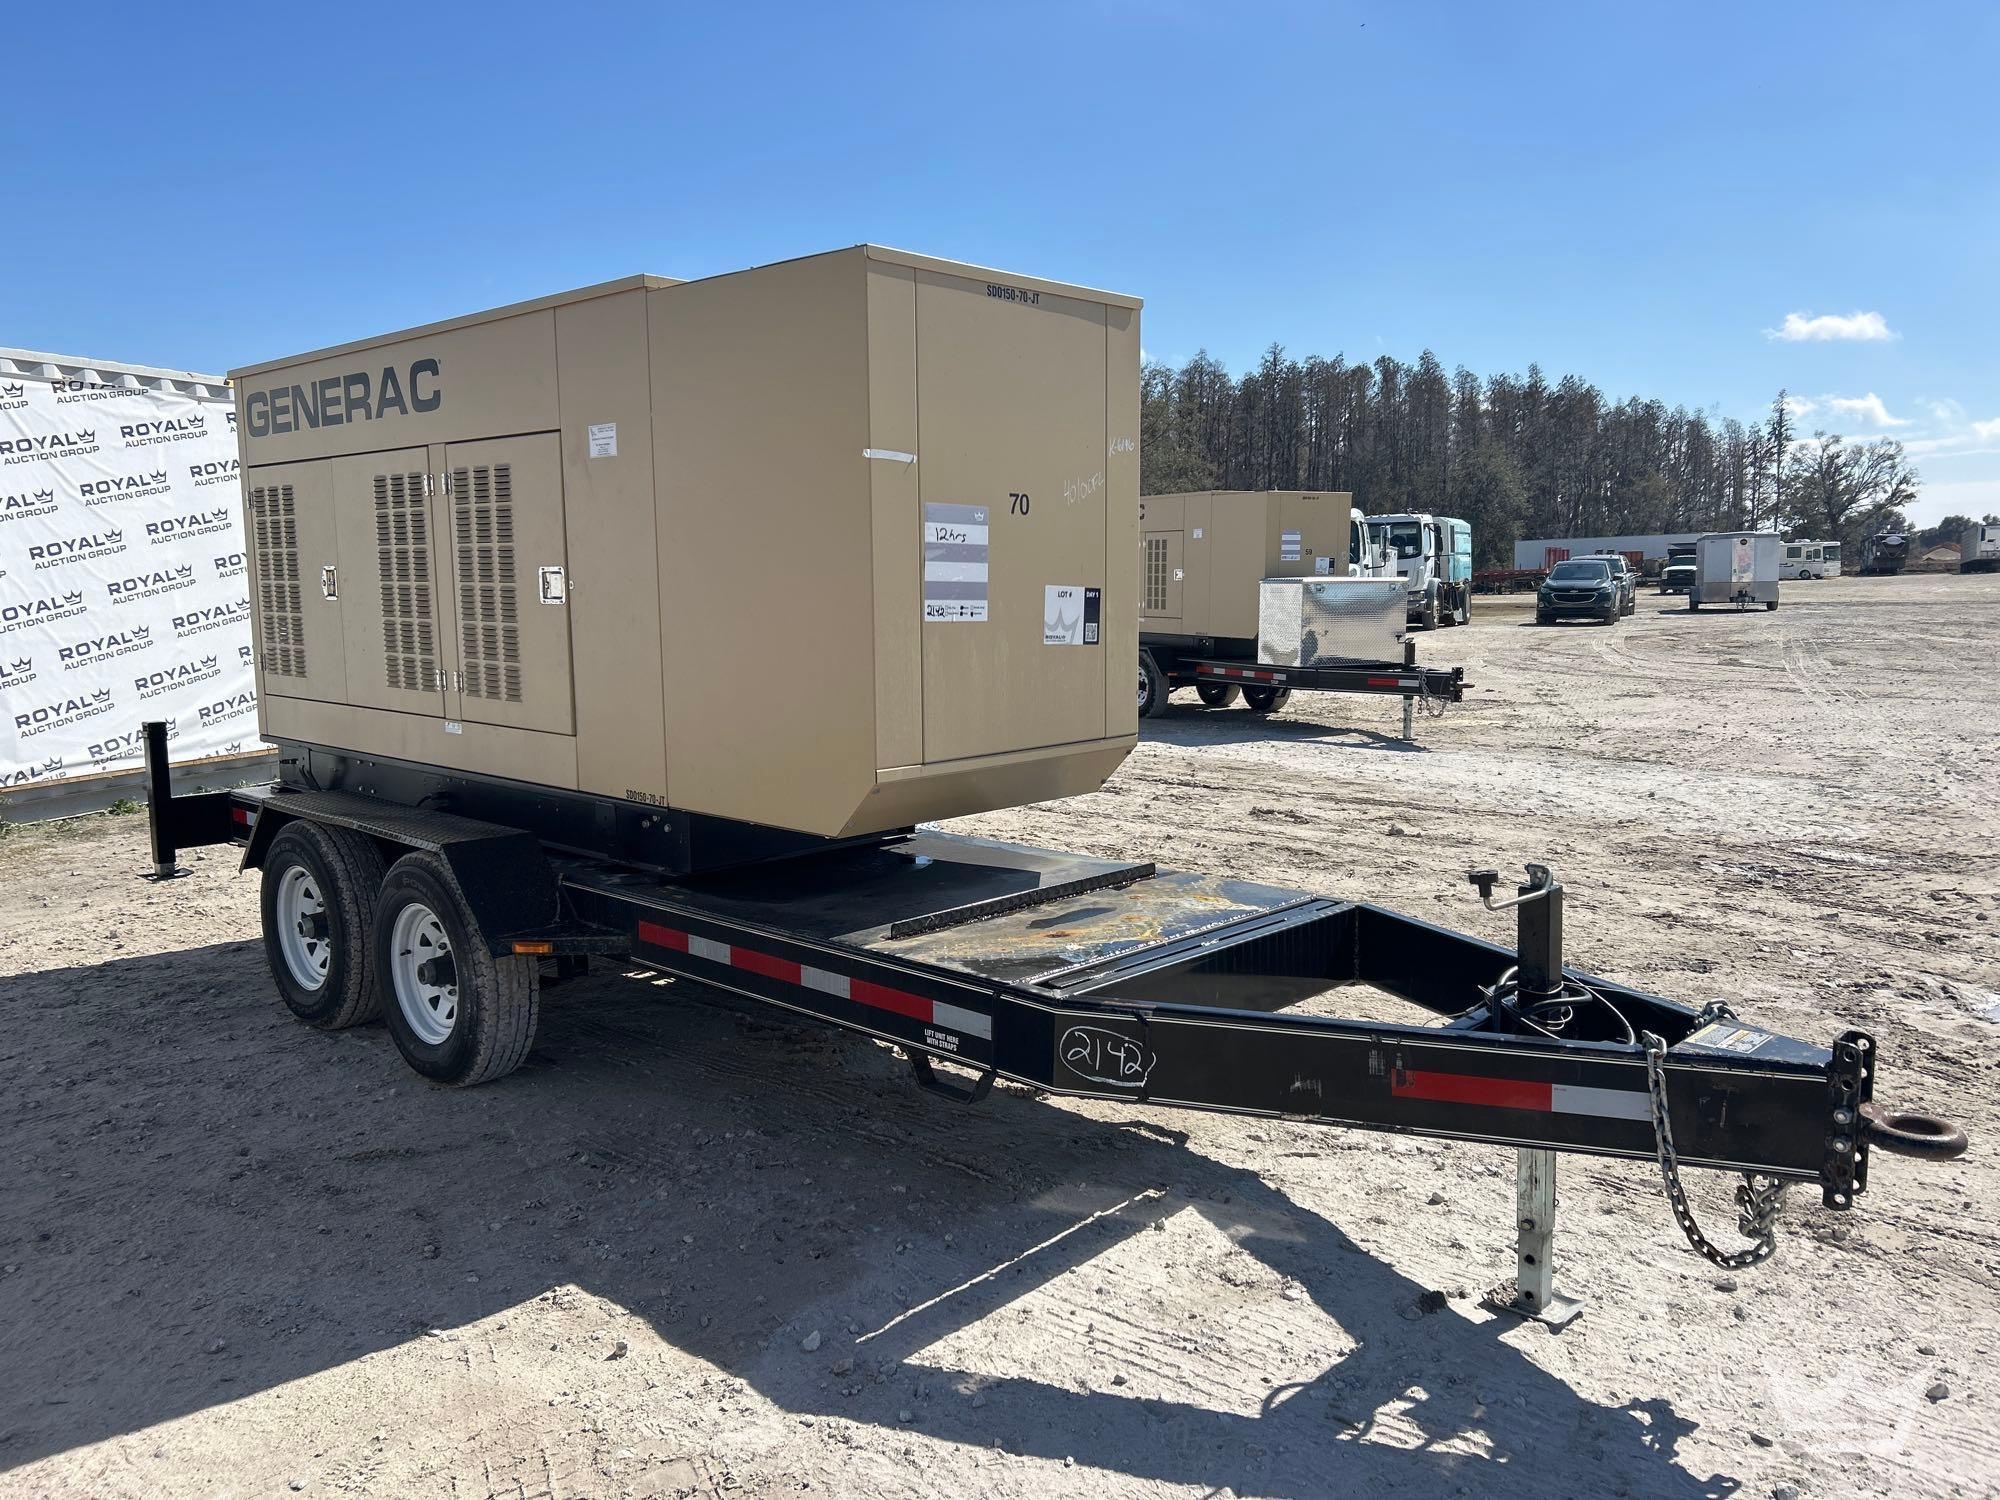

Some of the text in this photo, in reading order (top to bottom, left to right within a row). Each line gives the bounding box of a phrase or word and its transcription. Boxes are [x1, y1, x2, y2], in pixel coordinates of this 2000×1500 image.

[57, 388, 149, 404] AUCTION GROUP
[246, 358, 441, 438] GENERAC
[120, 419, 189, 438] ROYAL
[125, 430, 208, 448] AUCTION GROUP
[0, 433, 78, 454] ROYAL
[4, 445, 100, 465] AUCTION GROUP
[190, 459, 240, 478] ROYA
[194, 473, 238, 487] AUCTION
[79, 474, 151, 496] ROYAL
[85, 485, 171, 507] AUCTION GROUP
[16, 505, 59, 519] GROUP
[1009, 493, 1030, 515] 70
[146, 512, 213, 536] ROYAL
[150, 522, 232, 545] AUCTION GROUP
[29, 534, 106, 560] ROYAL
[35, 544, 127, 570] AUCTION GROUP
[107, 570, 177, 596] ROYAL
[112, 579, 197, 605] AUCTION GROUP
[0, 597, 65, 621] OYAL
[0, 606, 88, 634] UCTION GROUP
[172, 603, 237, 630] ROYAL
[176, 612, 250, 638] AUCTION GROU
[58, 632, 133, 661] ROYAL
[64, 640, 154, 671] AUCTION GROUP
[134, 662, 202, 691] ROYAL
[139, 668, 221, 700] AUCTION GROUP
[14, 696, 93, 728] ROYAL
[20, 702, 115, 739] AUCTION GROUP
[201, 708, 245, 728] AUCTION
[88, 729, 143, 758] ROYA
[93, 745, 143, 767] AUCTION
[924, 1028, 959, 1045] LIFT UNIT HERE
[926, 1036, 957, 1052] WITH STRAPS
[1067, 1031, 1143, 1077] 2142
